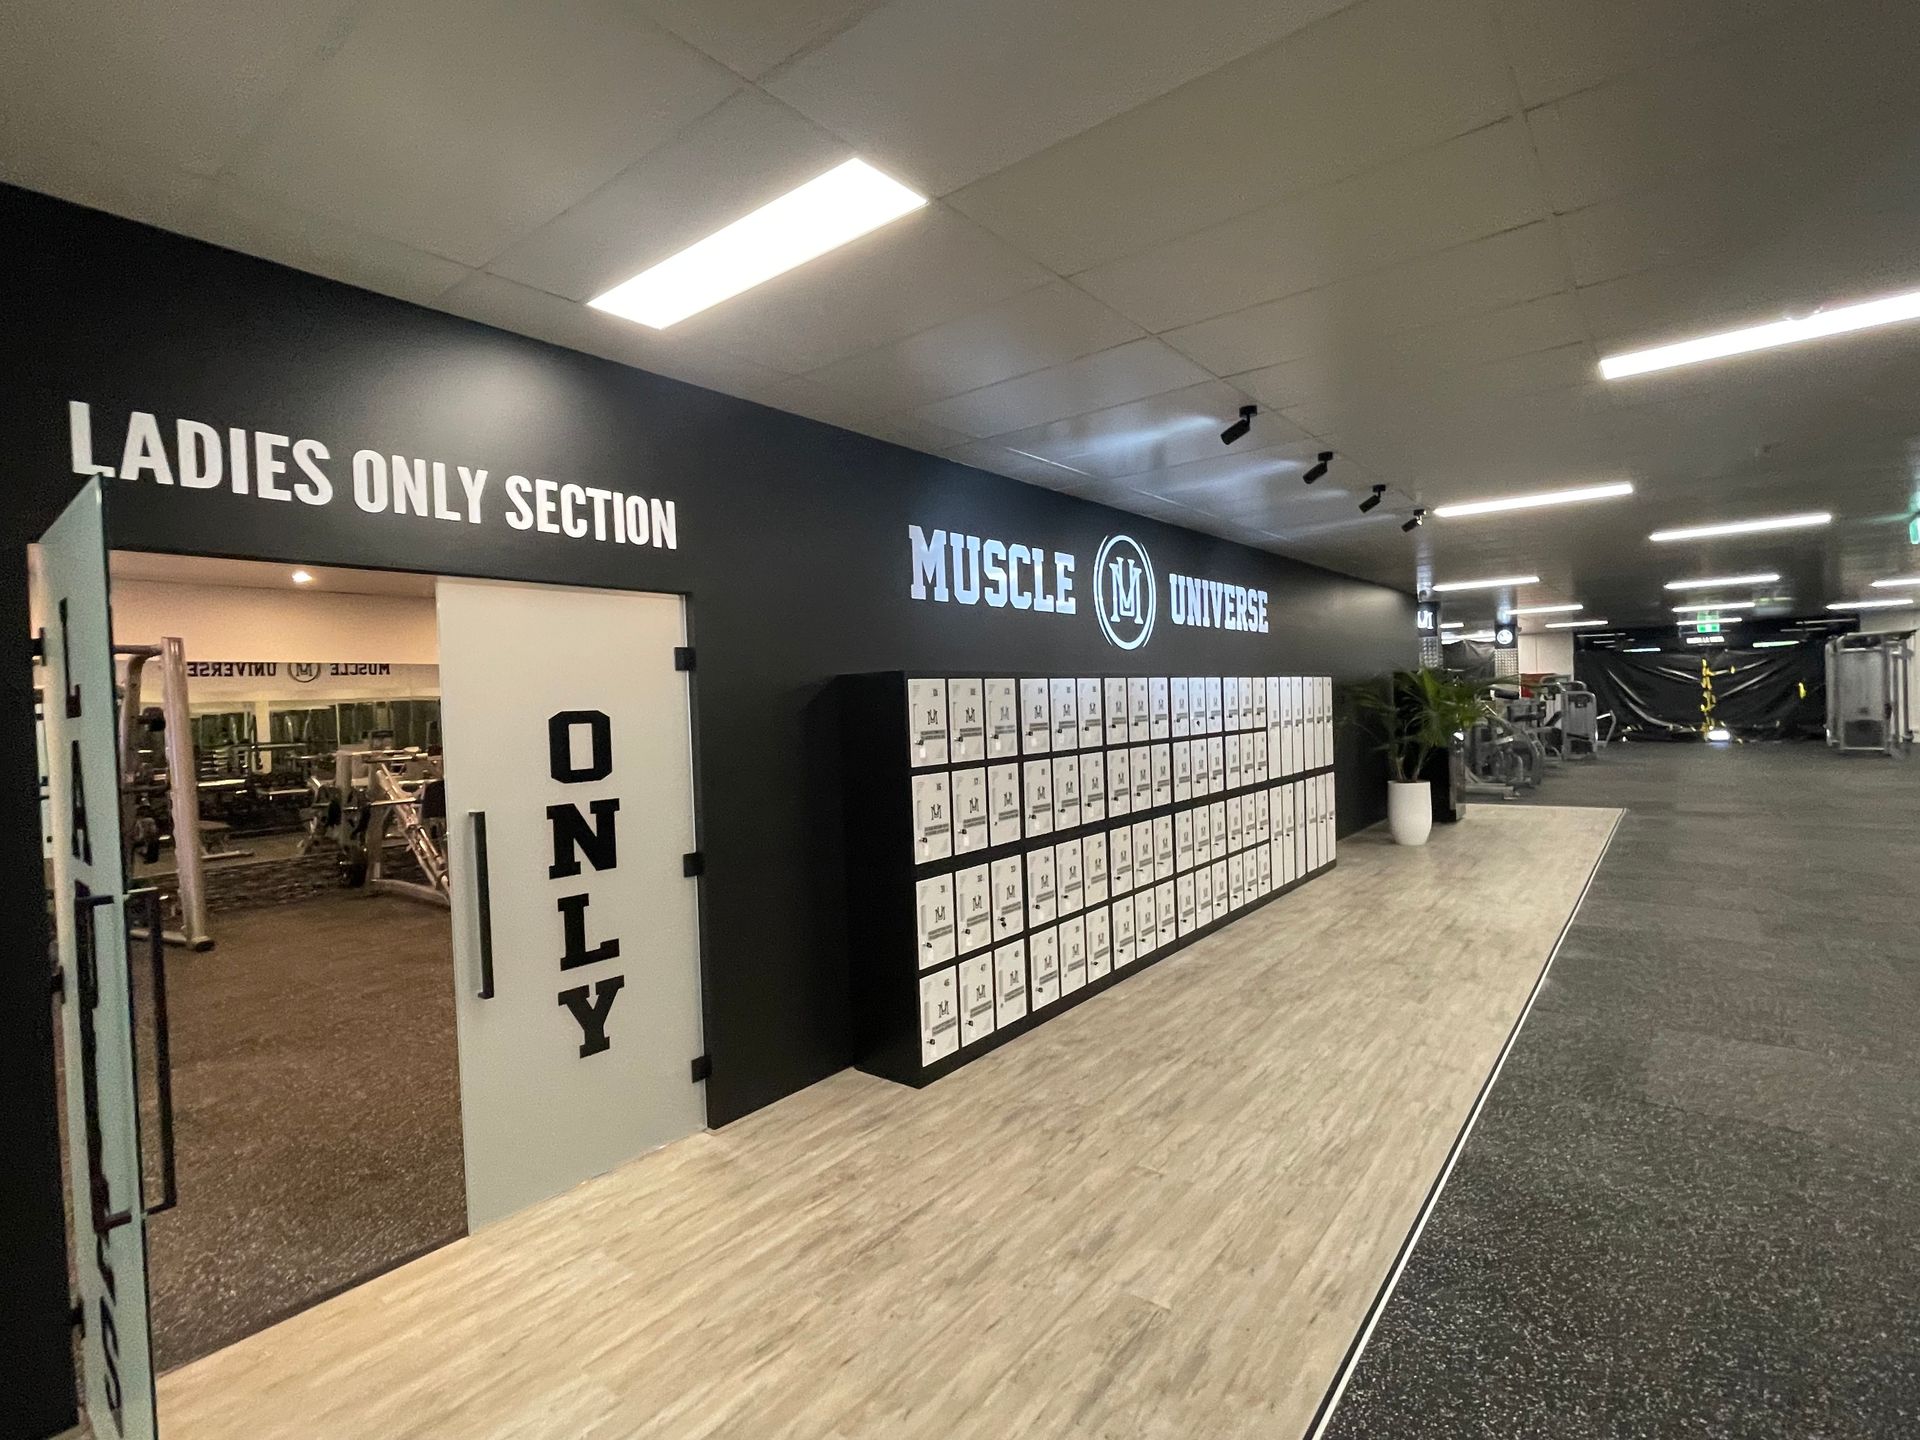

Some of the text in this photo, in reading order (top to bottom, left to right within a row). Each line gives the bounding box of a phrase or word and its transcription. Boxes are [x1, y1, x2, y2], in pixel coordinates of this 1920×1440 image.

[68, 400, 678, 550] LADIES ONLY SECTION
[908, 524, 1077, 615] MUSCLE
[1168, 573, 1269, 634] UNIVERSE
[546, 710, 625, 1059] ONLY
